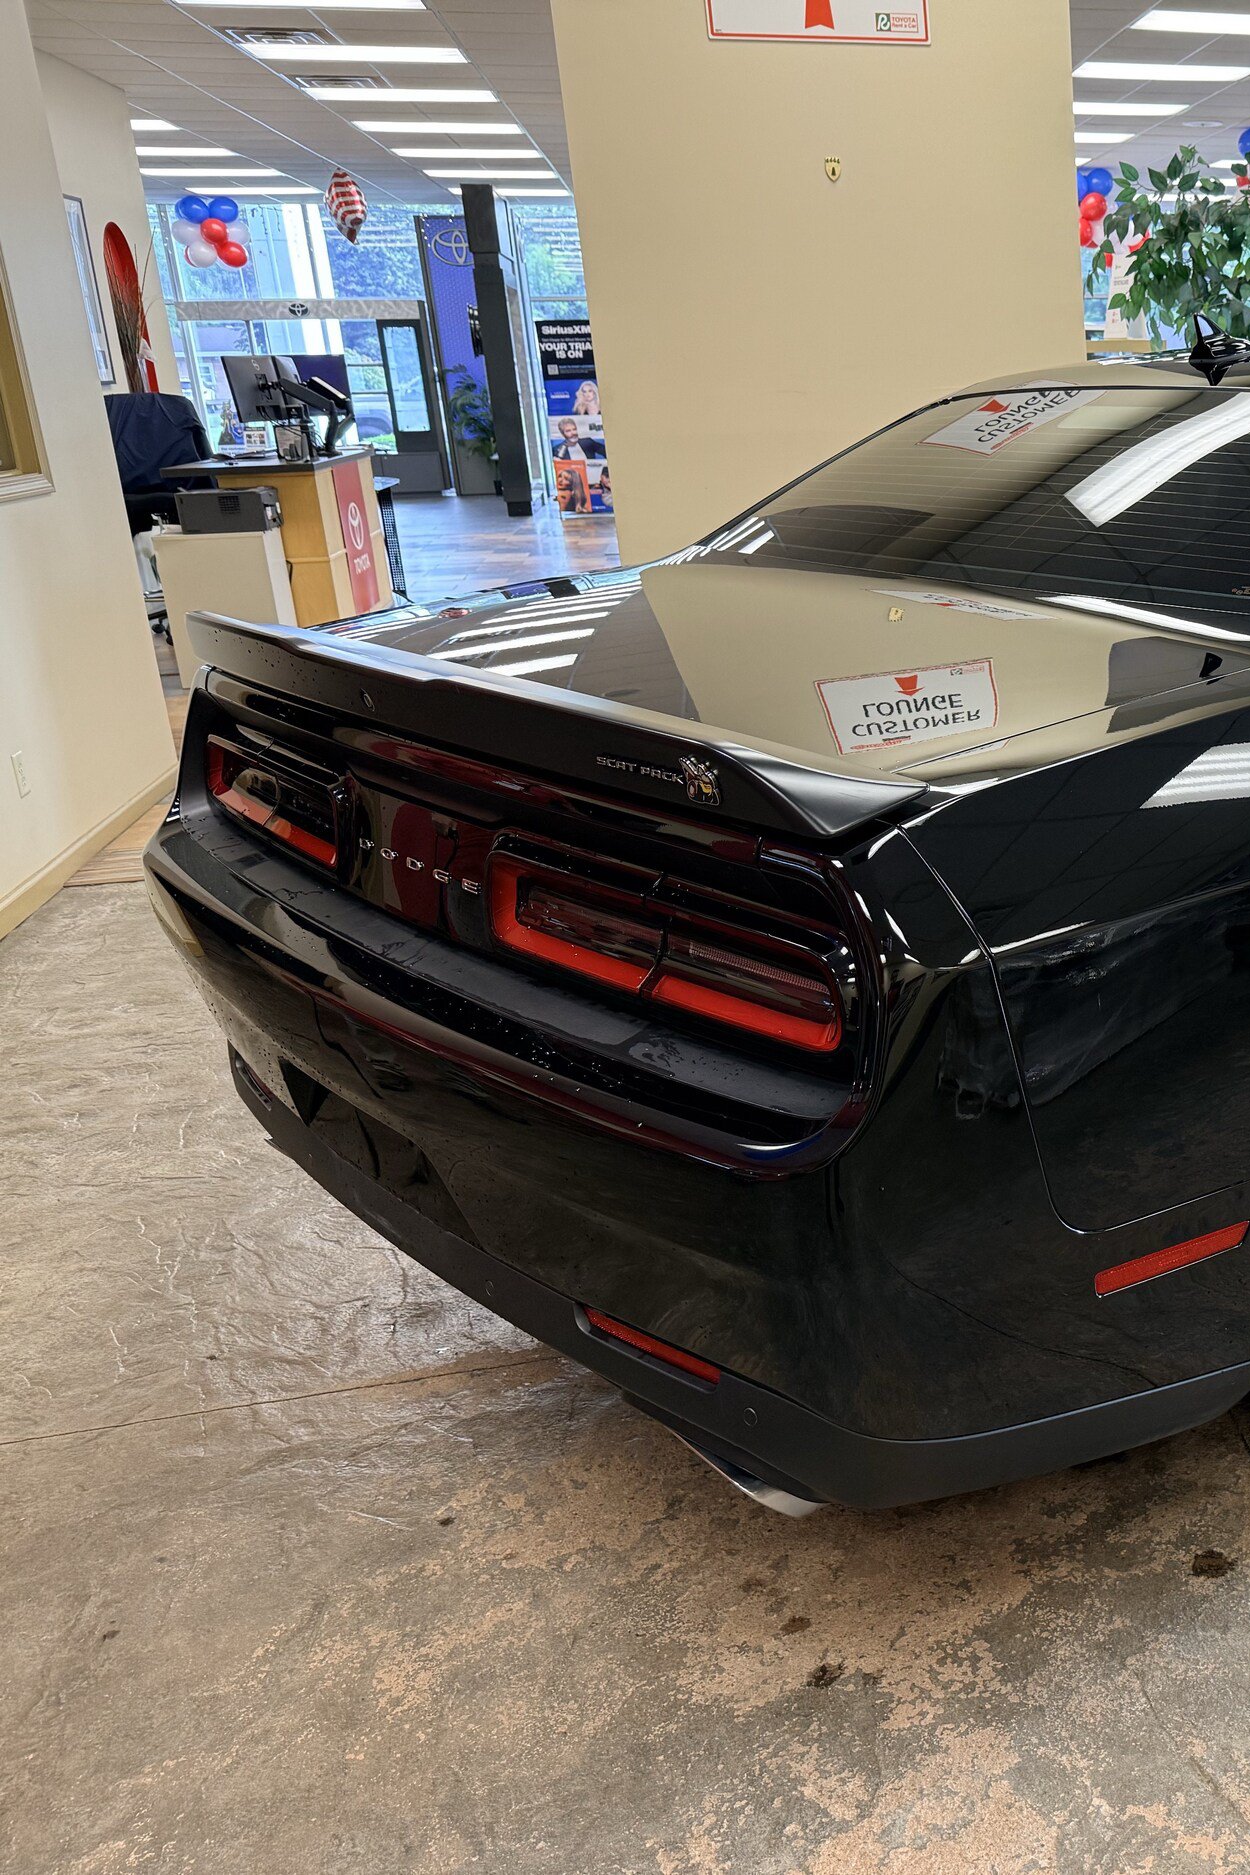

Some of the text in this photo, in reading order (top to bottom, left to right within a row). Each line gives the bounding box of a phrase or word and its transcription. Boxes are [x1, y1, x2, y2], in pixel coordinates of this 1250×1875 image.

[541, 324, 592, 335] SiriusXM
[539, 342, 593, 351] YOUR TRIA
[555, 350, 584, 359] IS ON
[596, 756, 684, 784] SCAT PACK
[359, 837, 480, 895] DODGE
